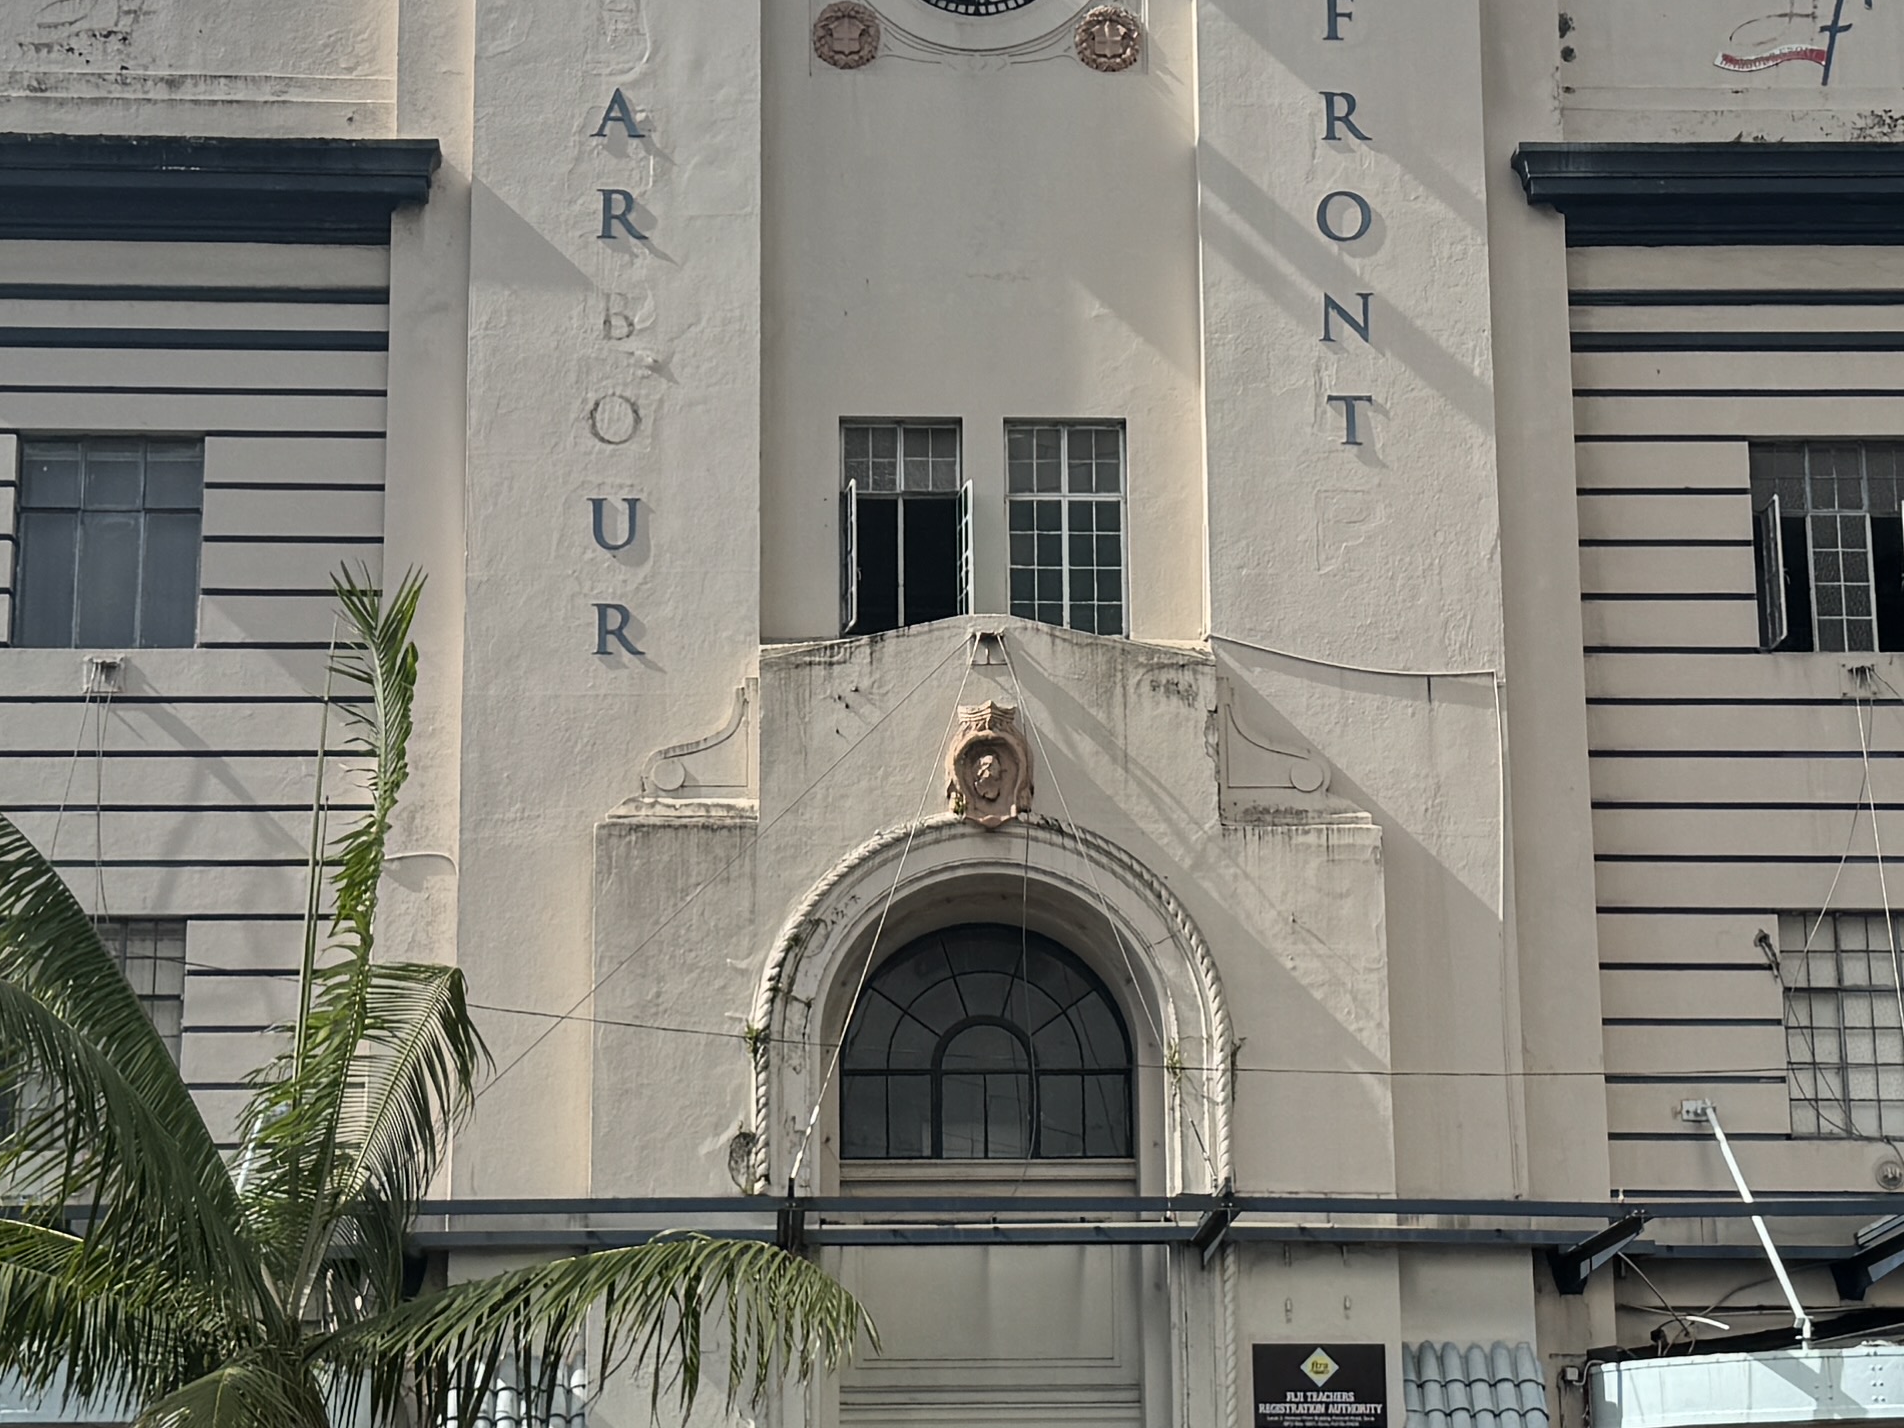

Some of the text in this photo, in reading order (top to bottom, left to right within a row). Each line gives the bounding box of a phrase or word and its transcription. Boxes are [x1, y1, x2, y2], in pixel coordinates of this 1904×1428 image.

[1286, 1391, 1355, 1402] FIJI TEACHERS
[1258, 1403, 1383, 1414] REGISTRATION AUTHORITY
